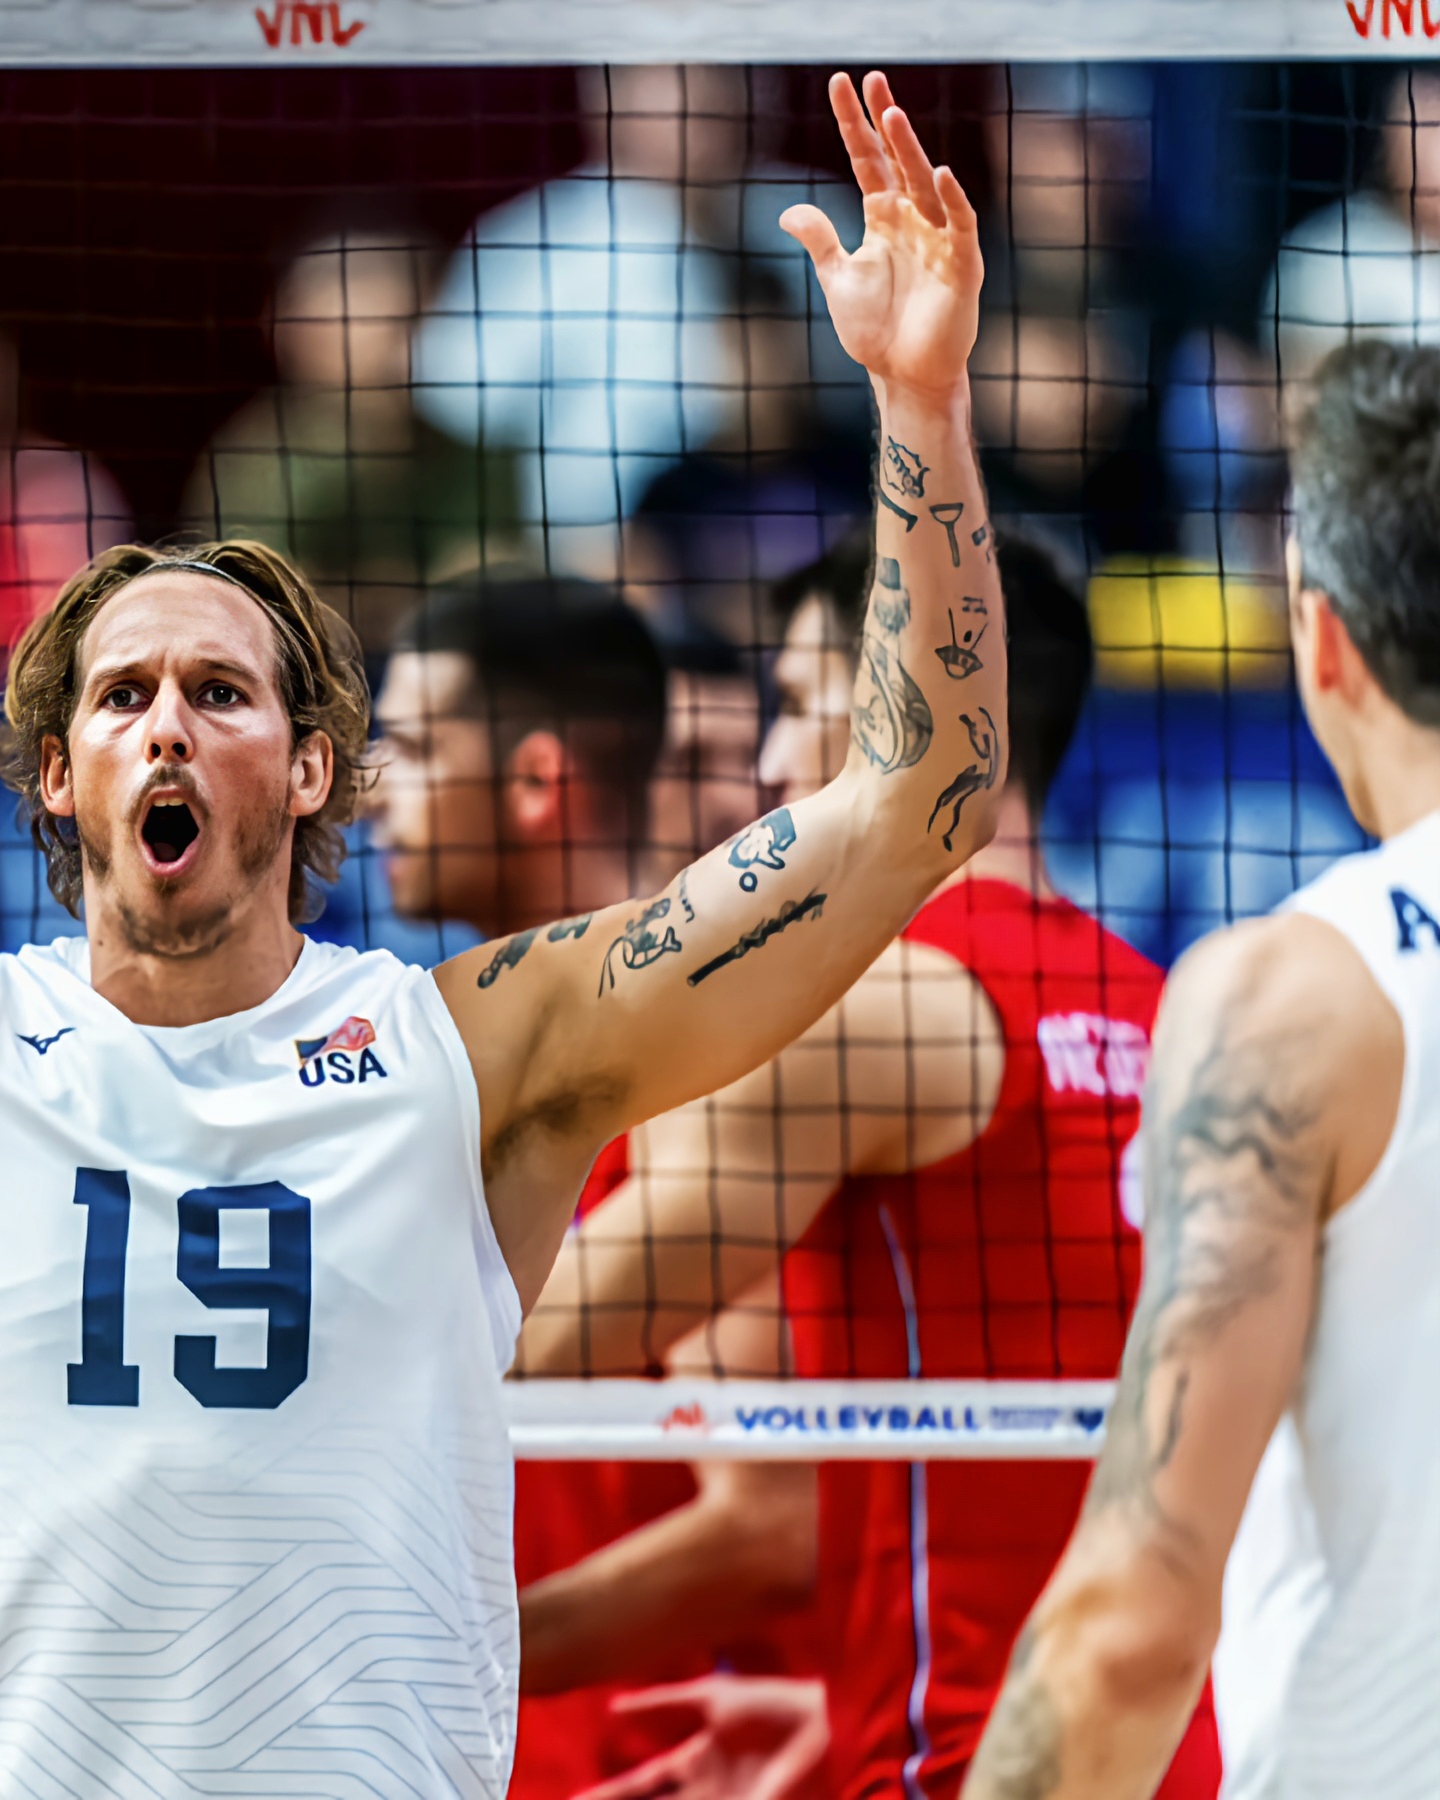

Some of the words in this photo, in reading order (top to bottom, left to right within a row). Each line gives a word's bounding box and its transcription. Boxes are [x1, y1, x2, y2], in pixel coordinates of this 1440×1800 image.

[255, 0, 366, 48] VNL
[298, 1046, 389, 1088] USA
[67, 1166, 312, 1410] 19
[735, 1404, 979, 1433] VOLLEYBALL
